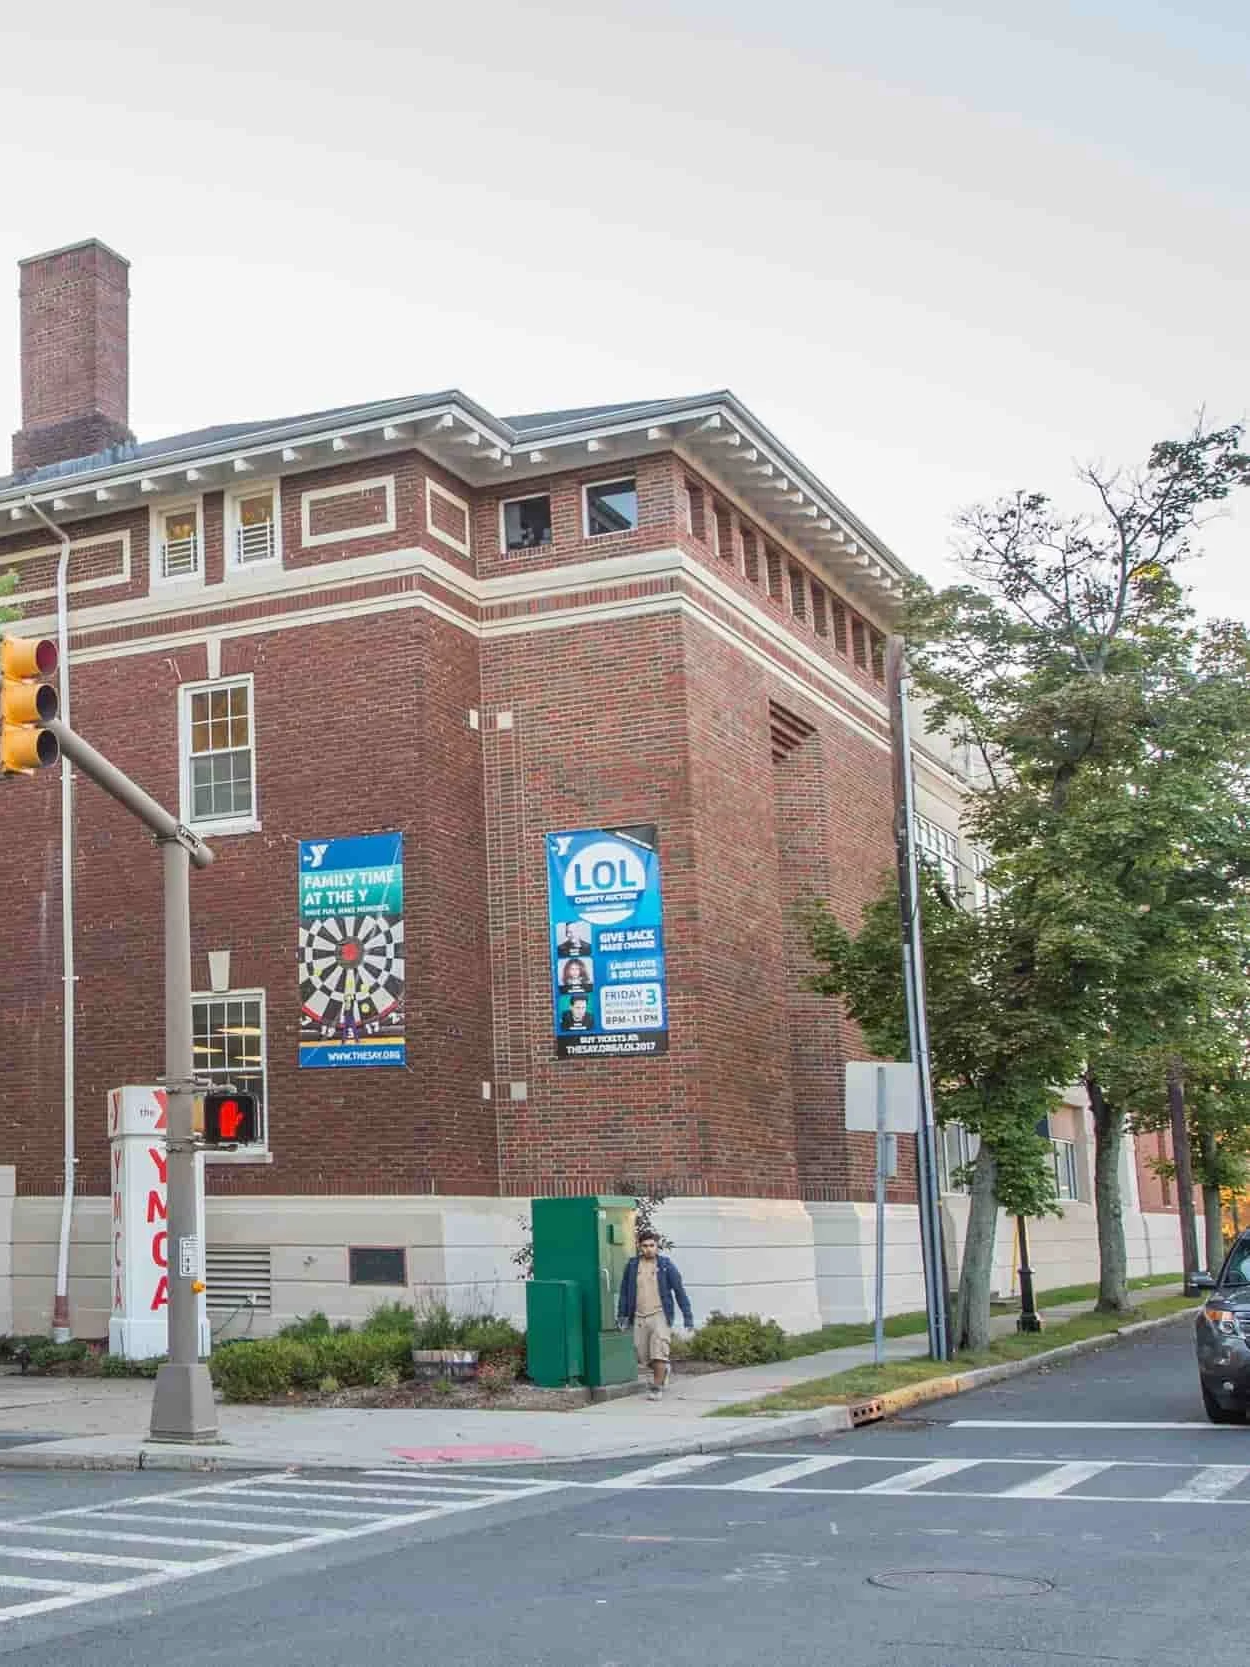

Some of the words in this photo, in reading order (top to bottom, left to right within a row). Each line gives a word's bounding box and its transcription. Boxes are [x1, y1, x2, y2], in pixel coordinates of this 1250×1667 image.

[303, 872, 355, 889] FAMILY
[358, 868, 395, 885] TIME
[574, 859, 637, 891] LOL
[303, 891, 323, 906] AT
[326, 889, 355, 905] THE
[358, 888, 369, 902] Y
[599, 932, 626, 943] GIVE
[626, 929, 655, 941] BACK
[605, 989, 643, 1001] FRIDAY
[645, 988, 657, 1006] 3
